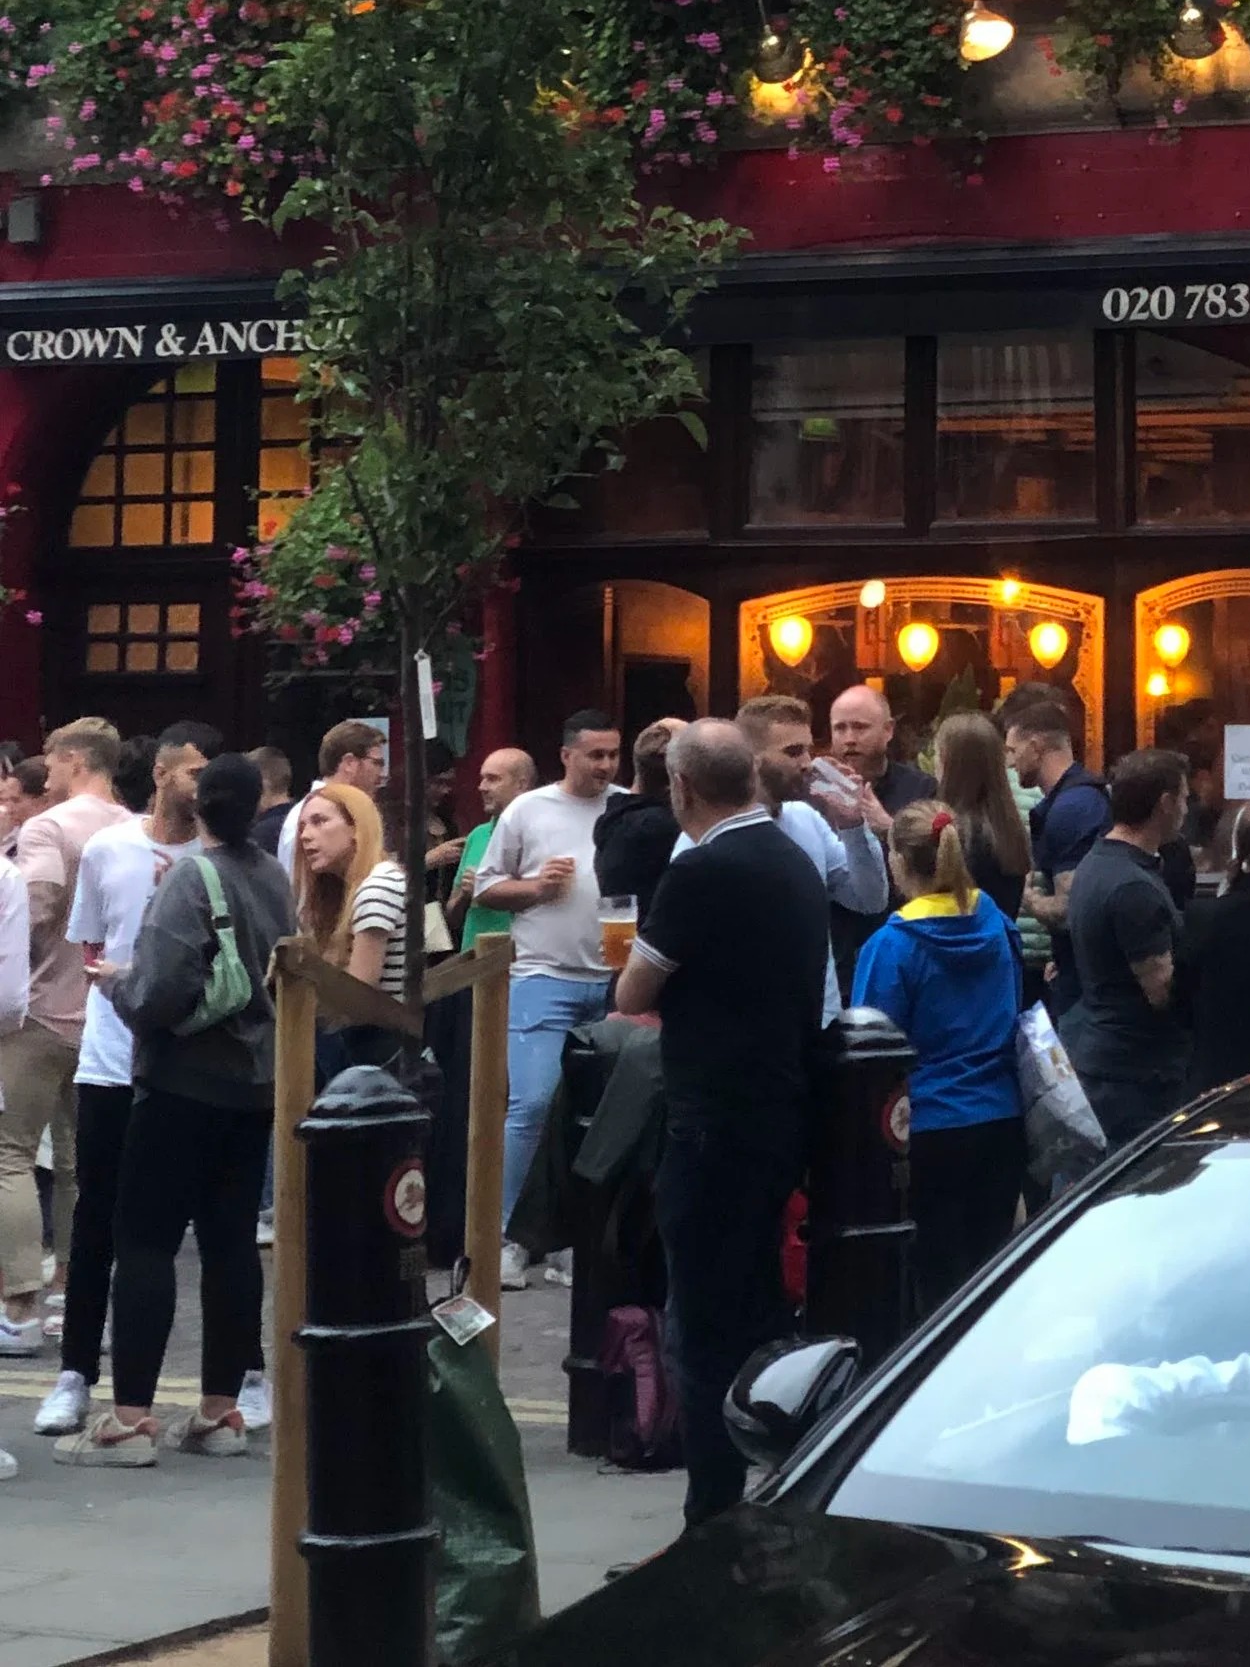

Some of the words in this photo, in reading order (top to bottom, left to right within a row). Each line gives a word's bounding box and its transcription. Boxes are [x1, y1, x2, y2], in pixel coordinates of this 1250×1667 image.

[1101, 286, 1176, 322] 020
[6, 324, 147, 362] CROWN
[155, 322, 186, 357] &
[189, 318, 348, 357] ANCHO
